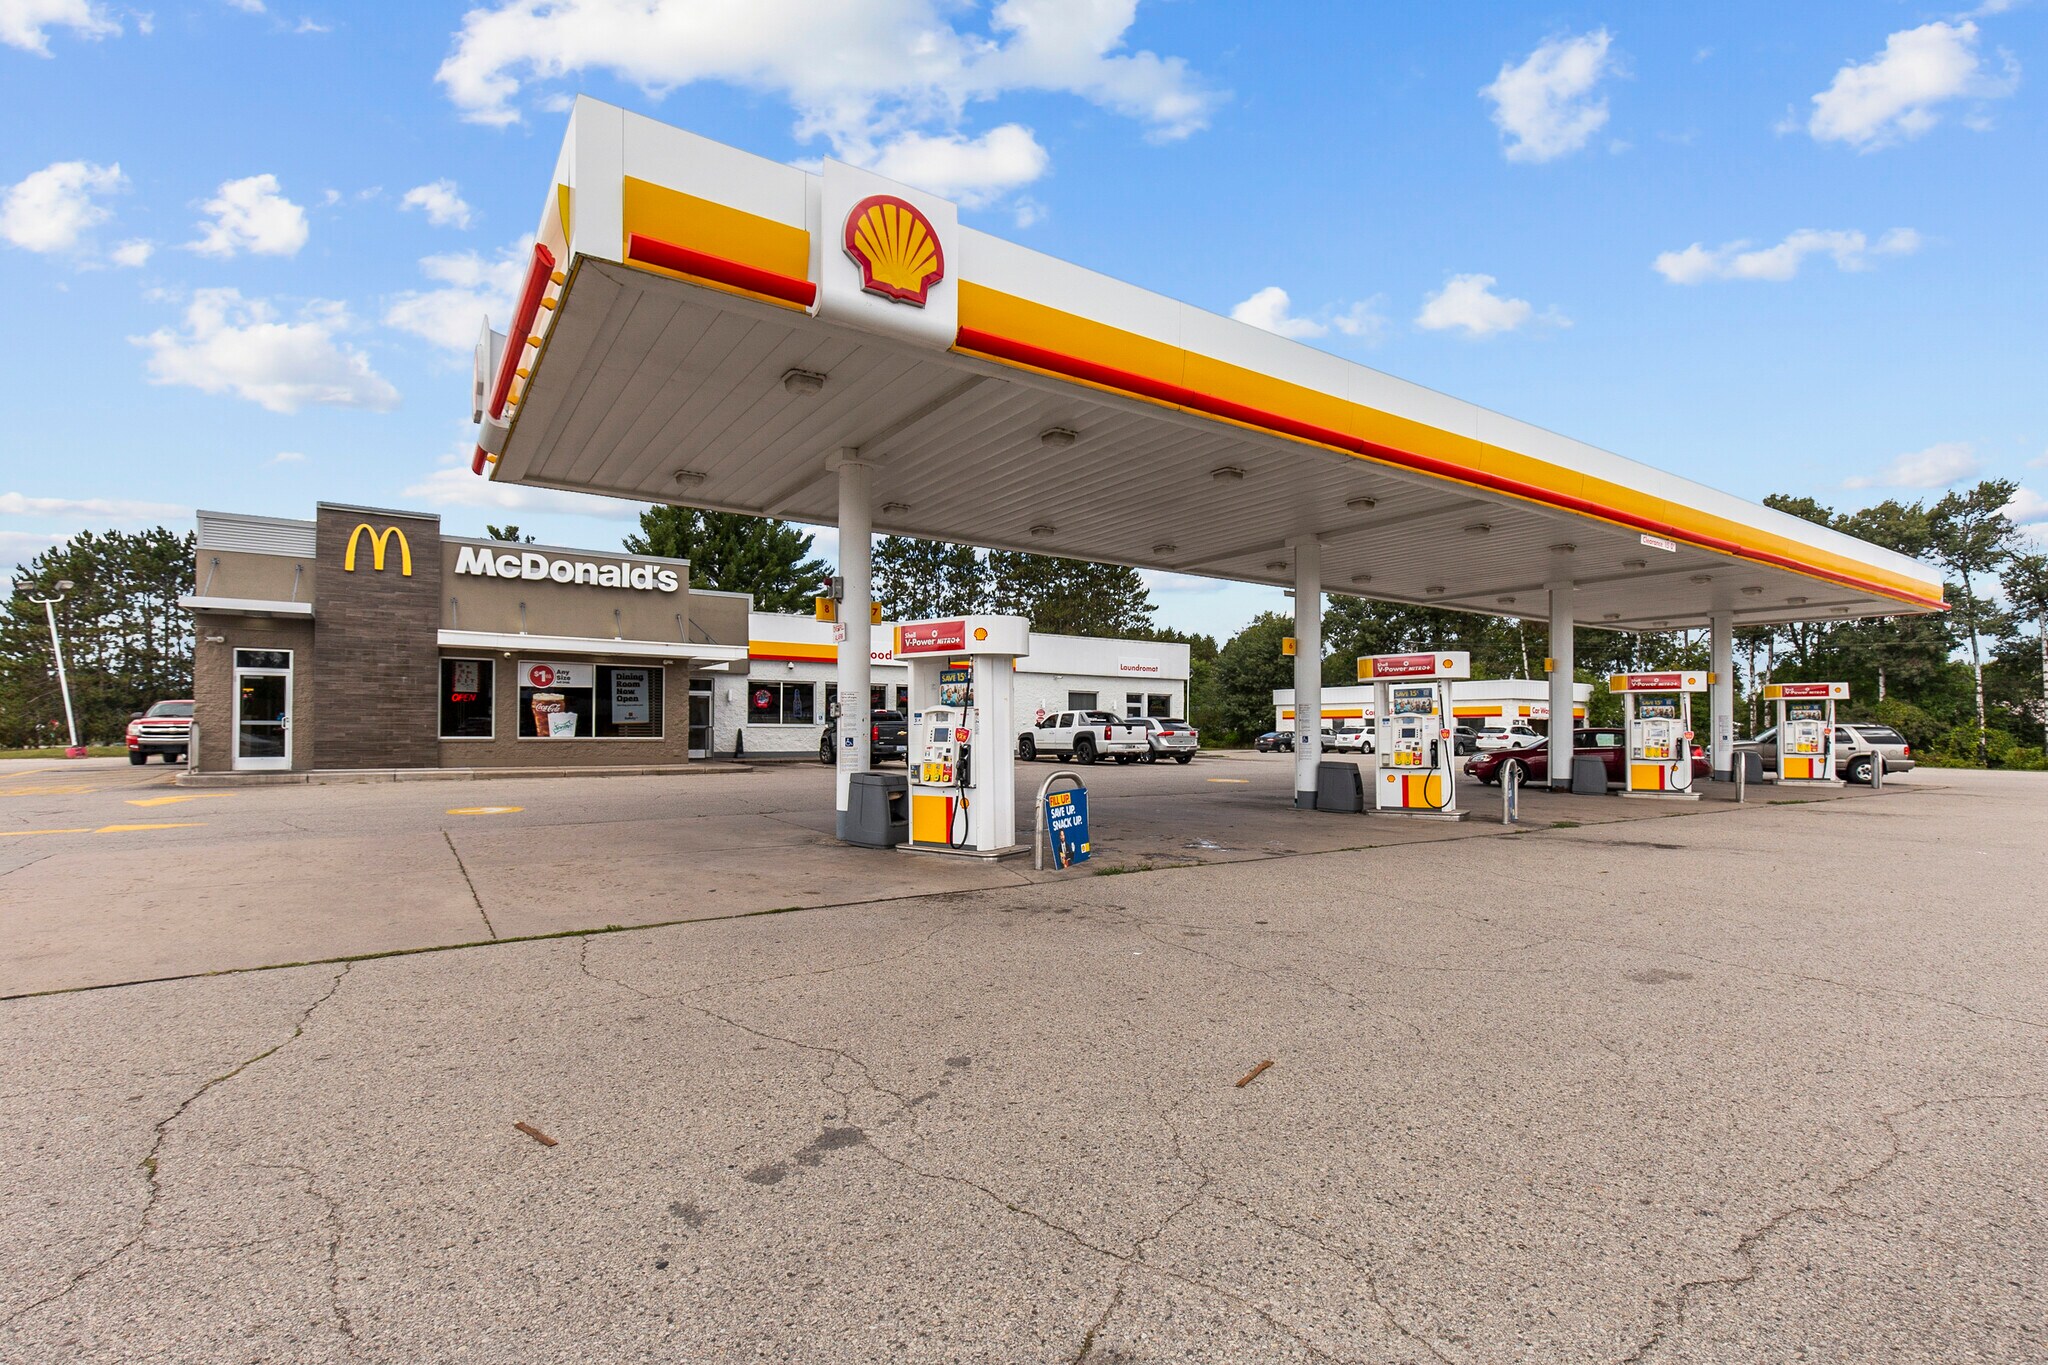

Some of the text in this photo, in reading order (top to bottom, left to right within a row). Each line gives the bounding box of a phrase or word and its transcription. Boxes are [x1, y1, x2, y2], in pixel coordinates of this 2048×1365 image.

[455, 546, 679, 593] McDonald's
[824, 604, 830, 614] 8
[872, 607, 878, 616] 7
[904, 631, 917, 639] Shell
[905, 638, 935, 647] V-Power
[870, 649, 893, 660] ood
[1120, 663, 1159, 673] Laundromat
[616, 672, 645, 682] Dining
[941, 674, 956, 683] SAVE
[616, 680, 641, 688] Room
[451, 693, 477, 702] OPEN
[616, 695, 640, 703] Open
[1049, 795, 1061, 806] FILL
[1050, 804, 1076, 819] SAVE UP.
[1052, 815, 1083, 831] SNACK UP.
